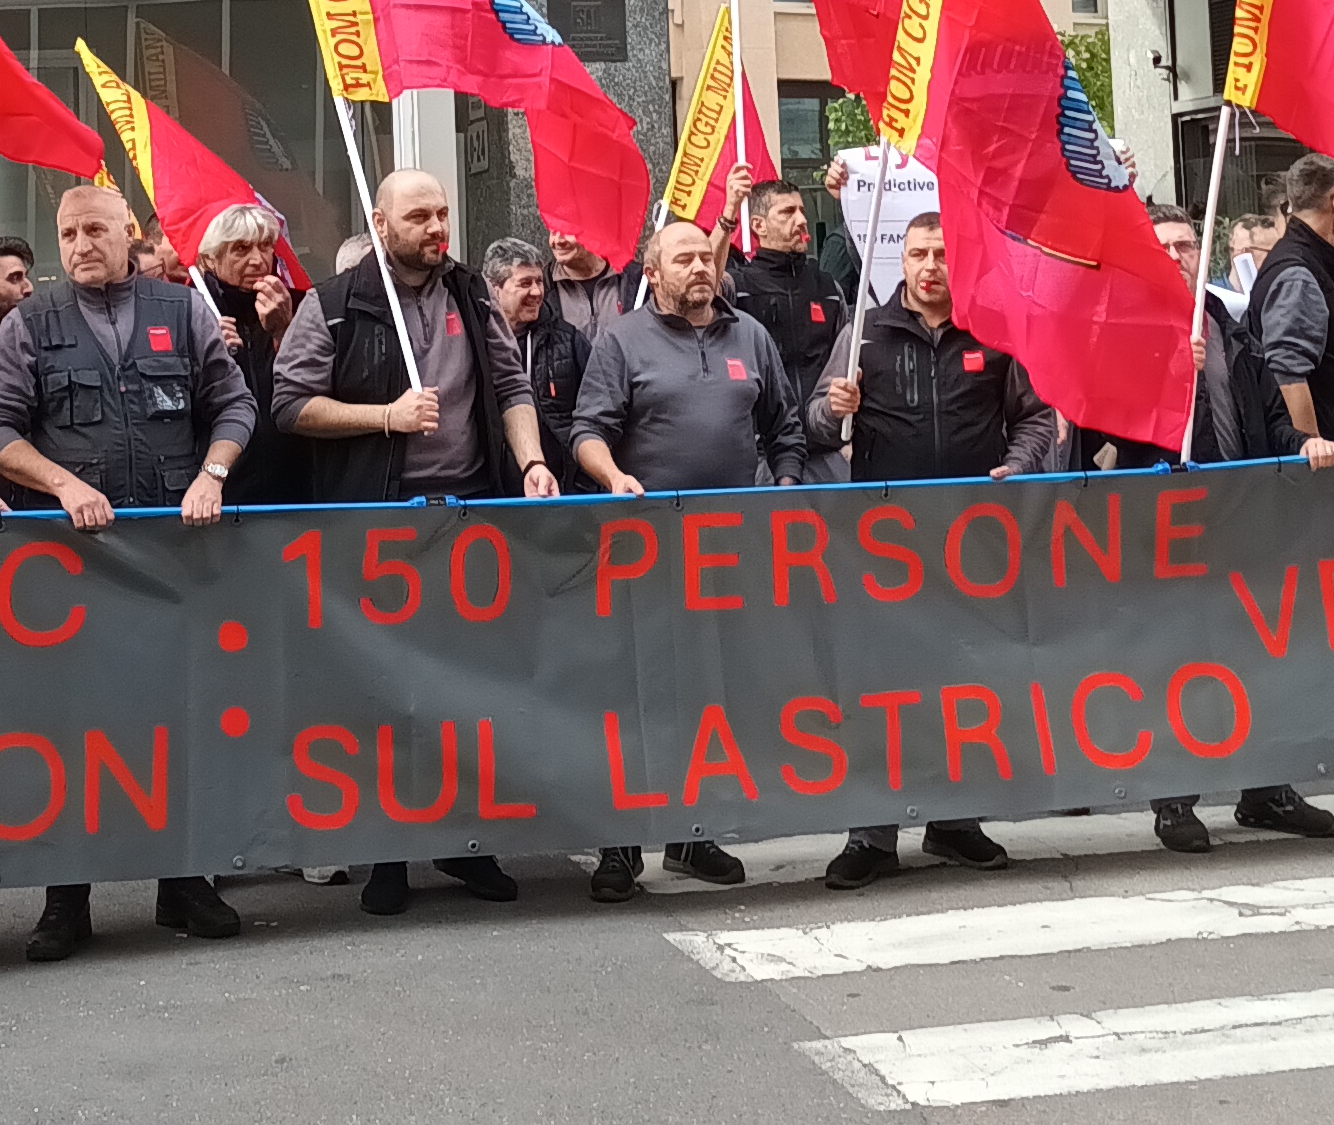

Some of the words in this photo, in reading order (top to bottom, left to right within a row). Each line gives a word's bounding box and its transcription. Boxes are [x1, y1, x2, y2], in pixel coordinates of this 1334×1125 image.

[326, 10, 373, 93] FIOM
[881, 39, 921, 139] FIOM
[687, 101, 725, 150] CGIL
[670, 151, 705, 212] FIOM
[857, 178, 935, 193] Prdictive
[880, 233, 905, 245] FAM
[281, 523, 514, 630] 150
[595, 487, 1211, 617] PERSONE
[285, 717, 538, 830] SUL
[604, 660, 1254, 812] LASTRICO
